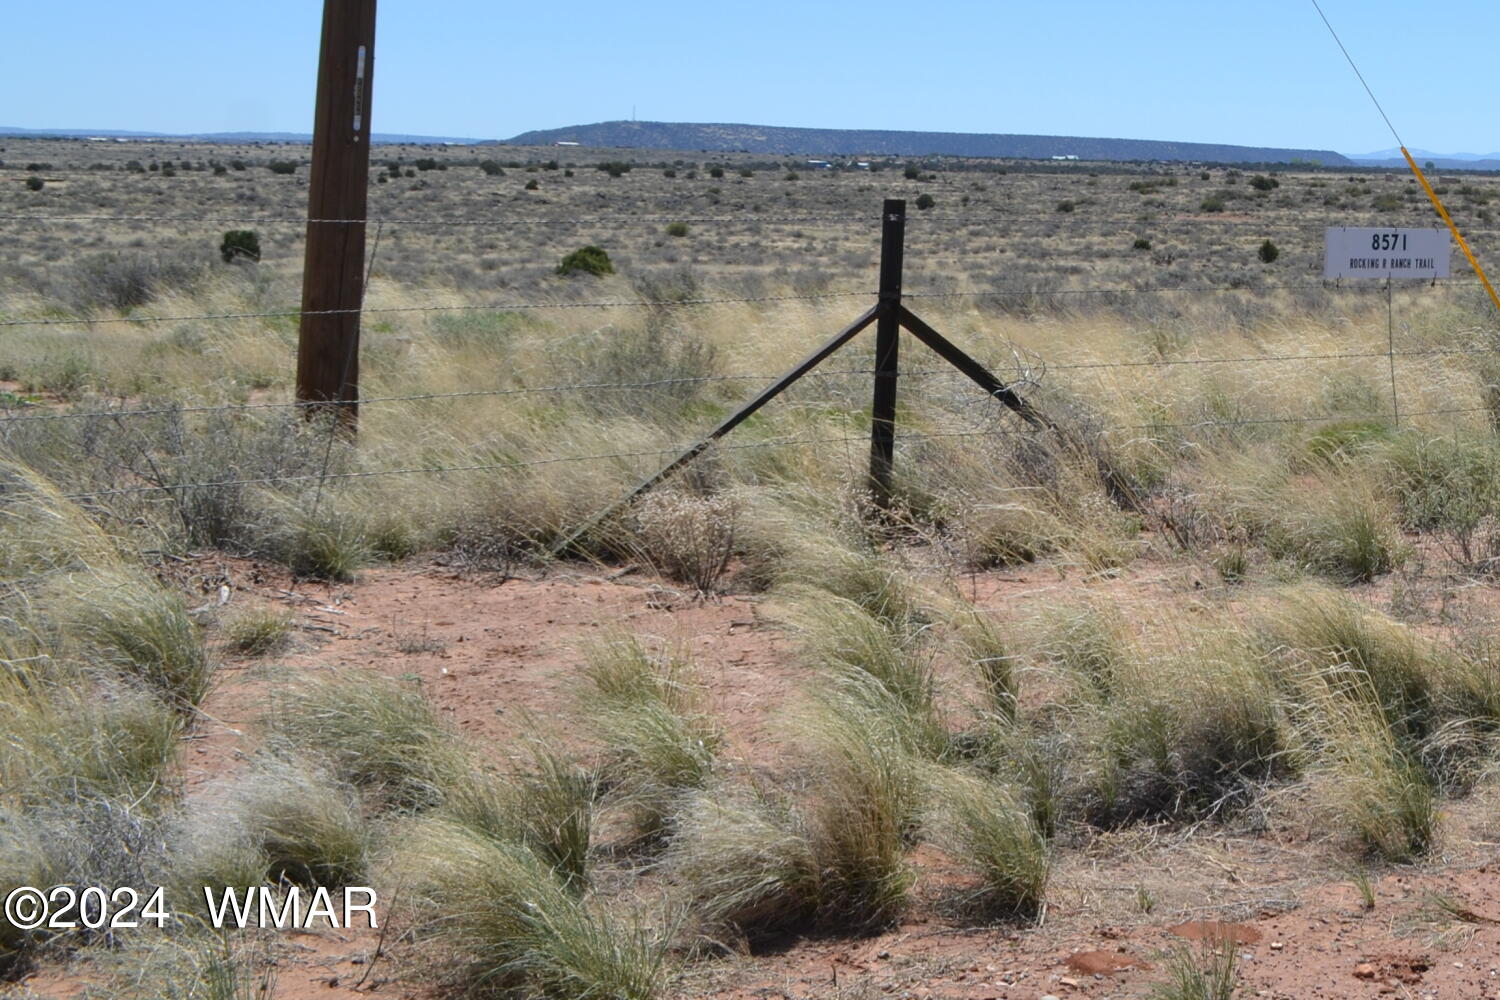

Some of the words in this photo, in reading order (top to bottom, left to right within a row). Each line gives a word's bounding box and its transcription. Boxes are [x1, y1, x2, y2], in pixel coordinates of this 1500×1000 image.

[1372, 234, 1407, 251] 8571
[1350, 258, 1379, 269] ROCKING
[1382, 258, 1387, 269] R
[1391, 258, 1411, 269] RANCH
[1415, 258, 1434, 269] TRAIL
